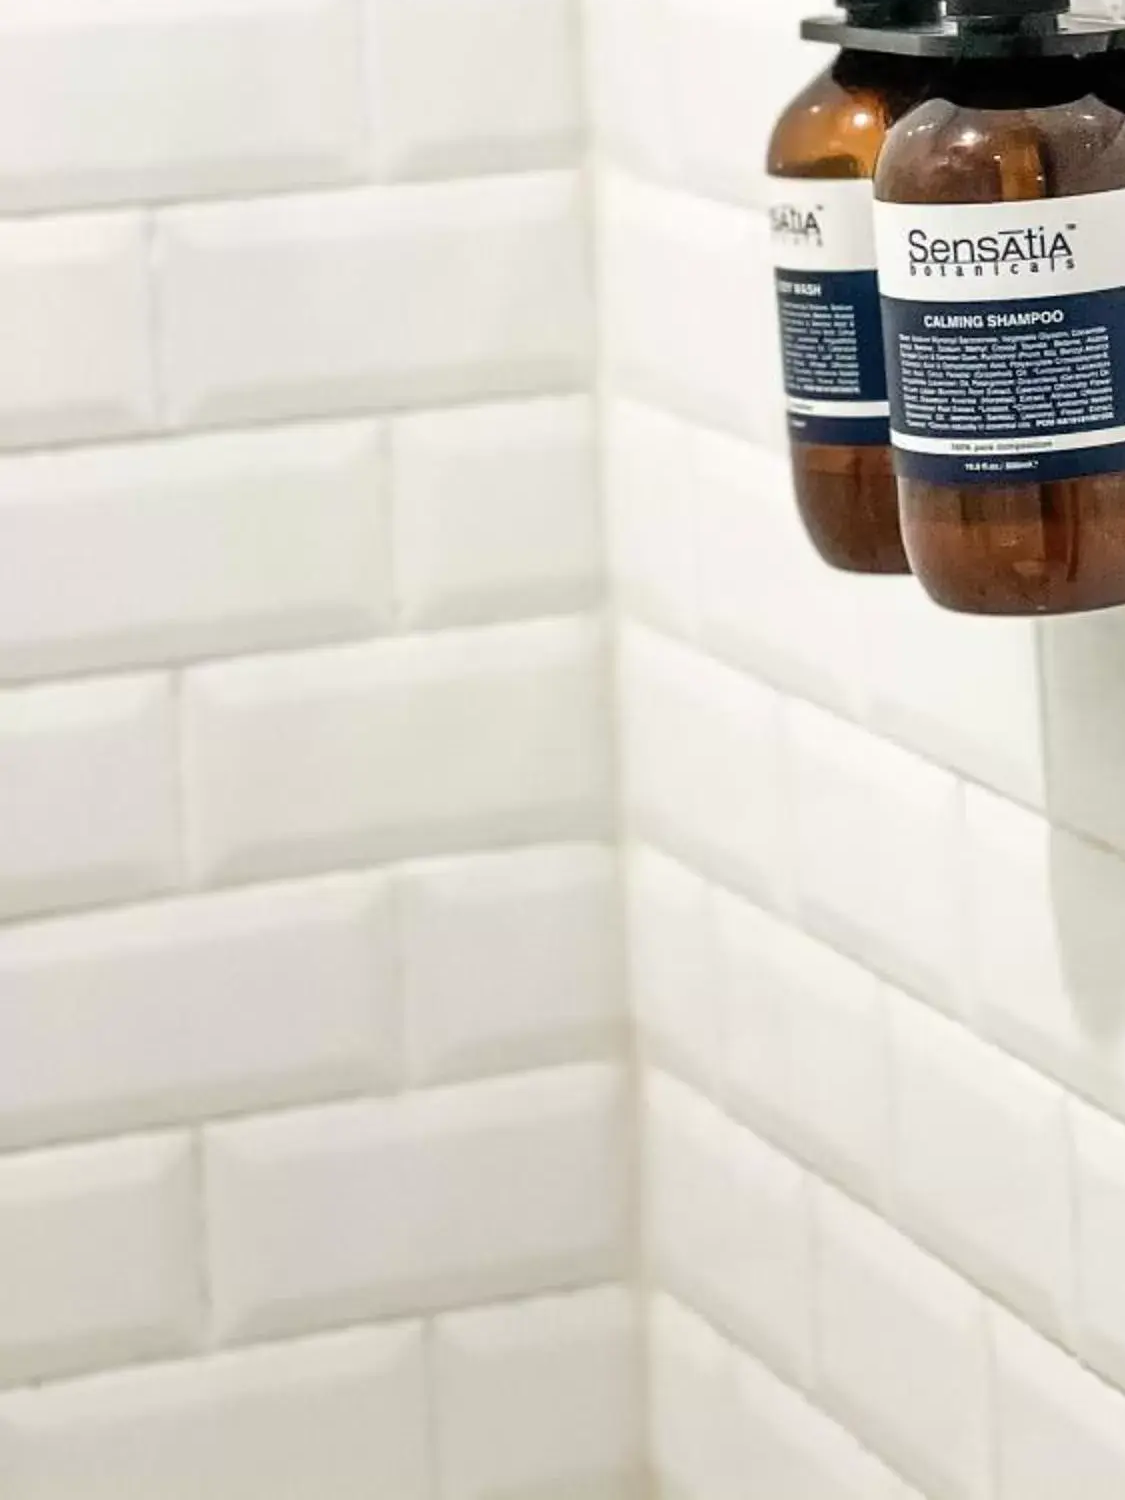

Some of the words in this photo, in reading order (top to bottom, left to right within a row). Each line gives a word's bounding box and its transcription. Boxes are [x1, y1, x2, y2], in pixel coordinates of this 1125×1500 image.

[909, 258, 1076, 277] botanicals
[793, 283, 822, 297] WASH
[923, 313, 985, 328] CALMING
[987, 309, 1065, 328] SHAMPOO
